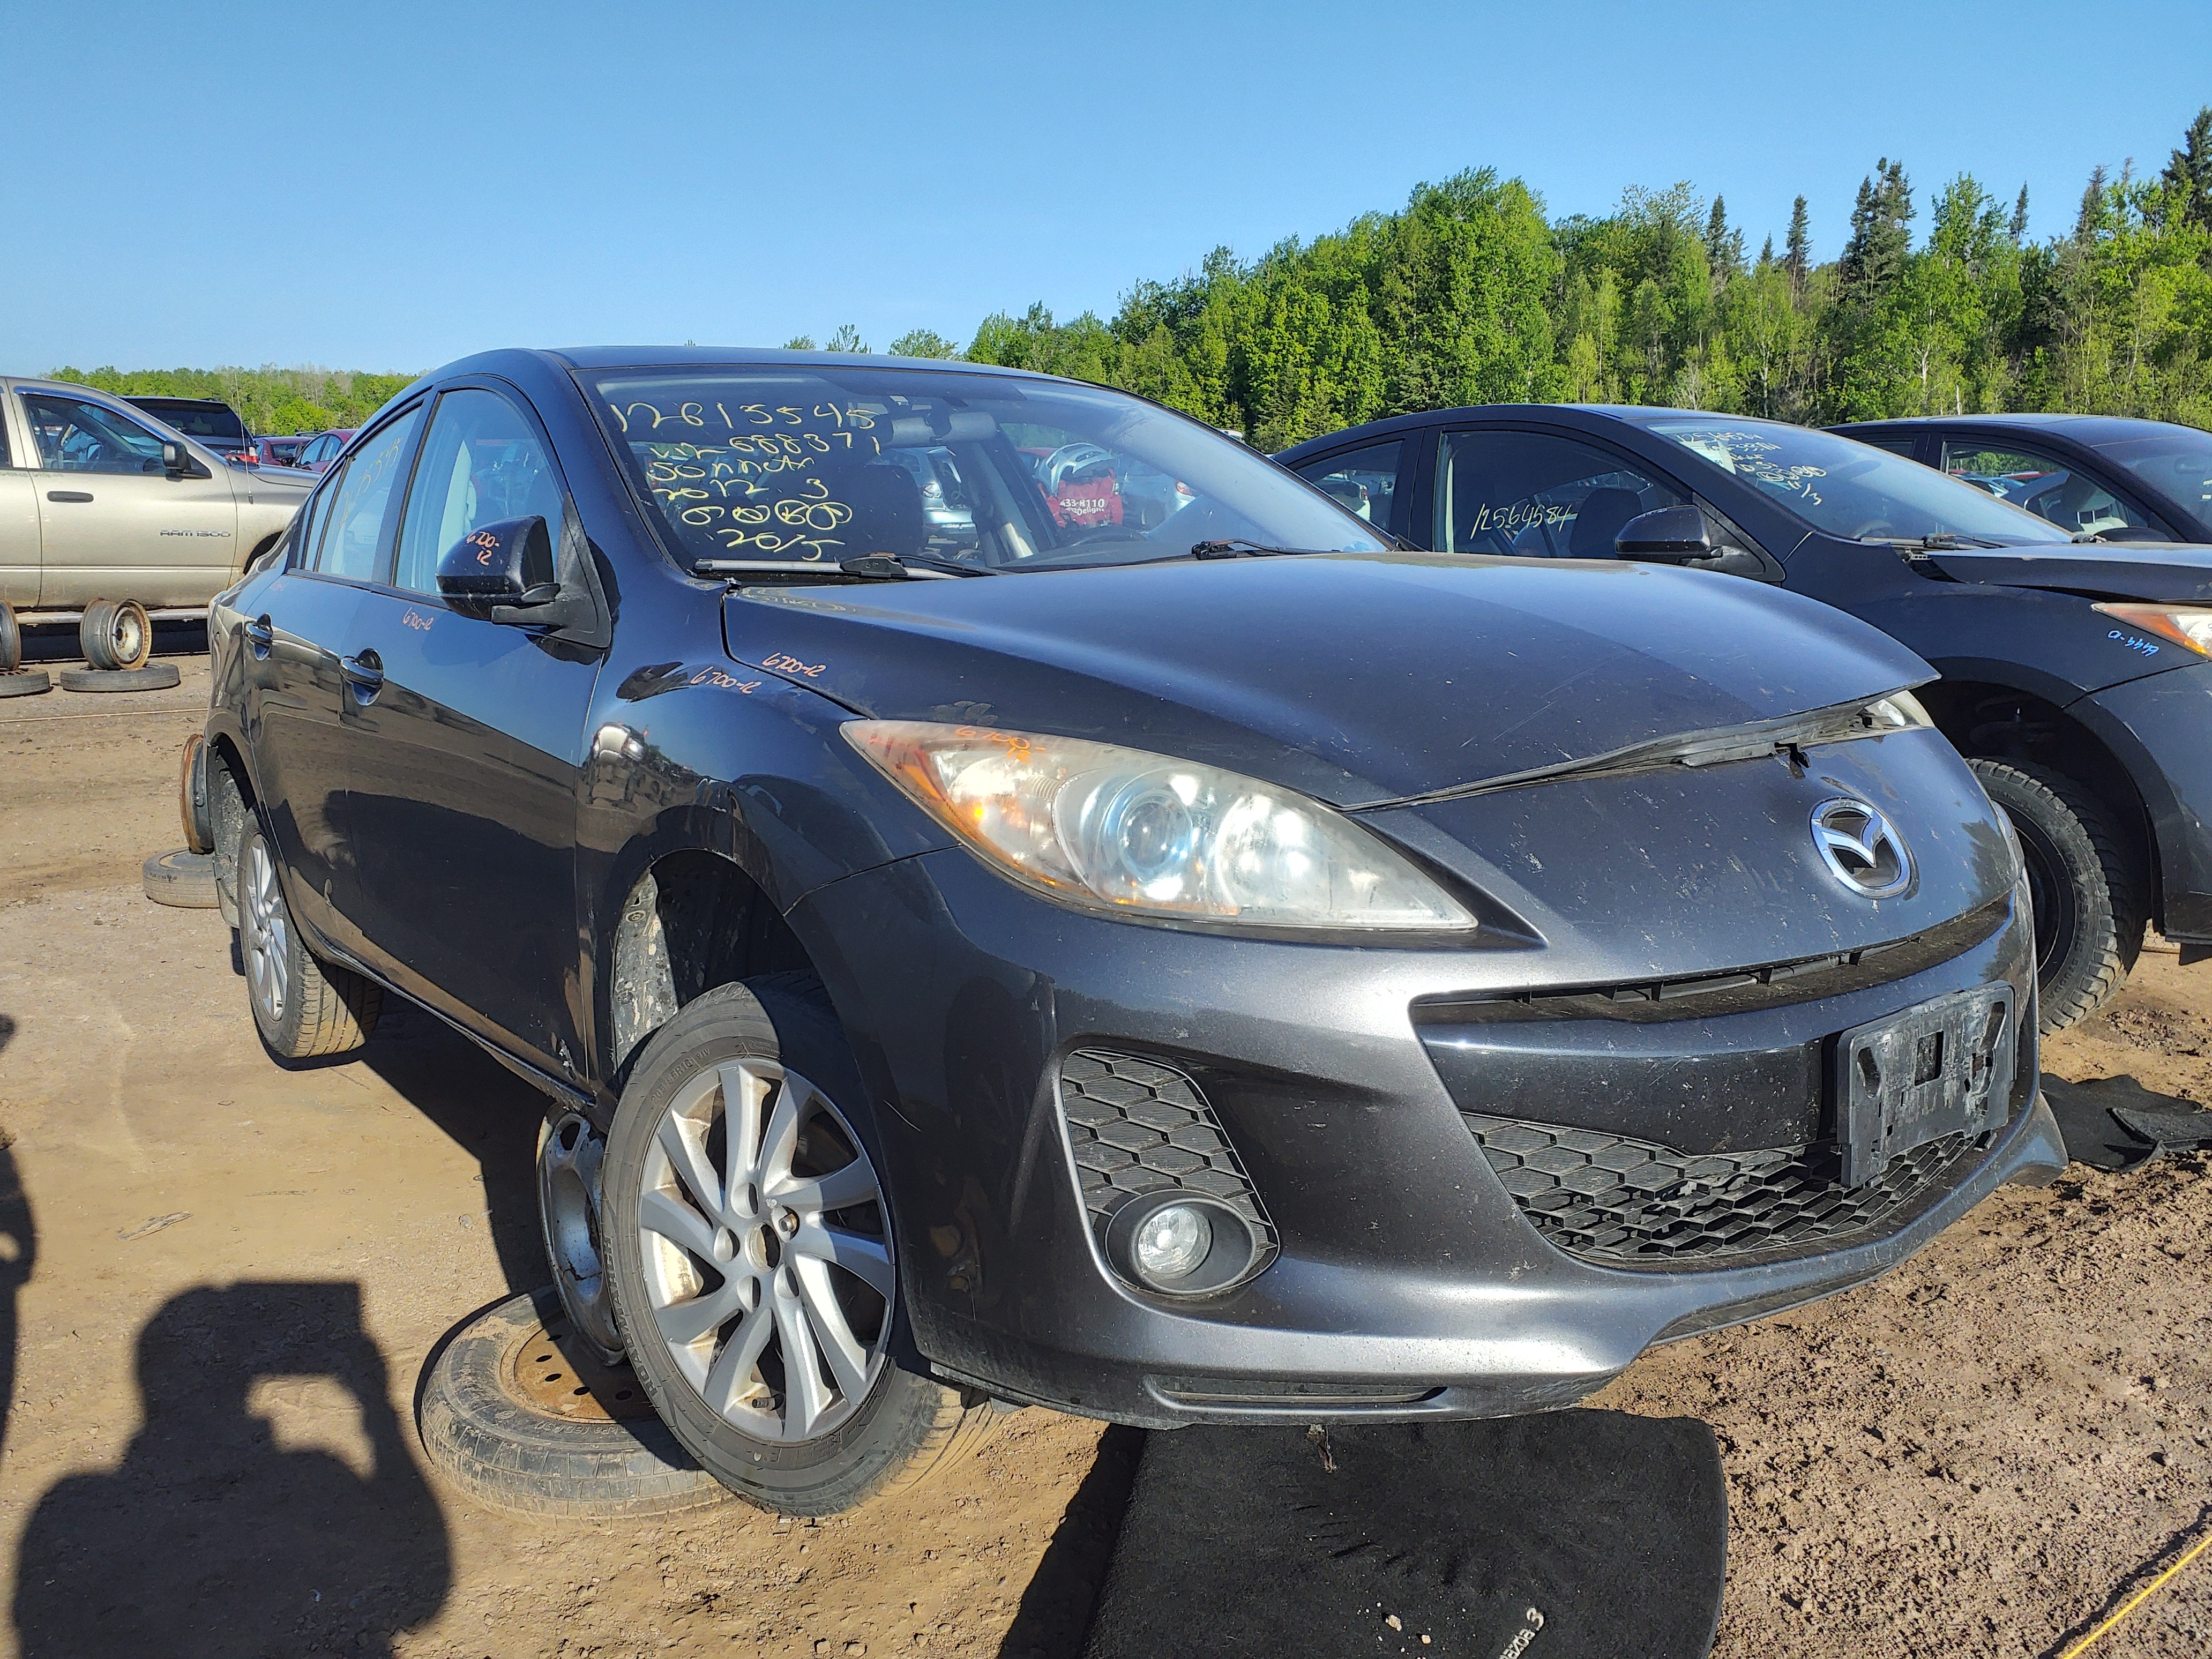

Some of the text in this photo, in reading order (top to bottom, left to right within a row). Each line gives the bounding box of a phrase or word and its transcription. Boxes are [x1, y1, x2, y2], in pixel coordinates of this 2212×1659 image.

[160, 529, 231, 538] RAM 1500
[1470, 503, 1577, 540] 12564584
[476, 549, 492, 566] 12
[762, 652, 827, 678] 6700-12
[690, 666, 763, 694] 6700-12
[603, 1235, 659, 1397] ROADMARCH
[1526, 1606, 1544, 1631] 3
